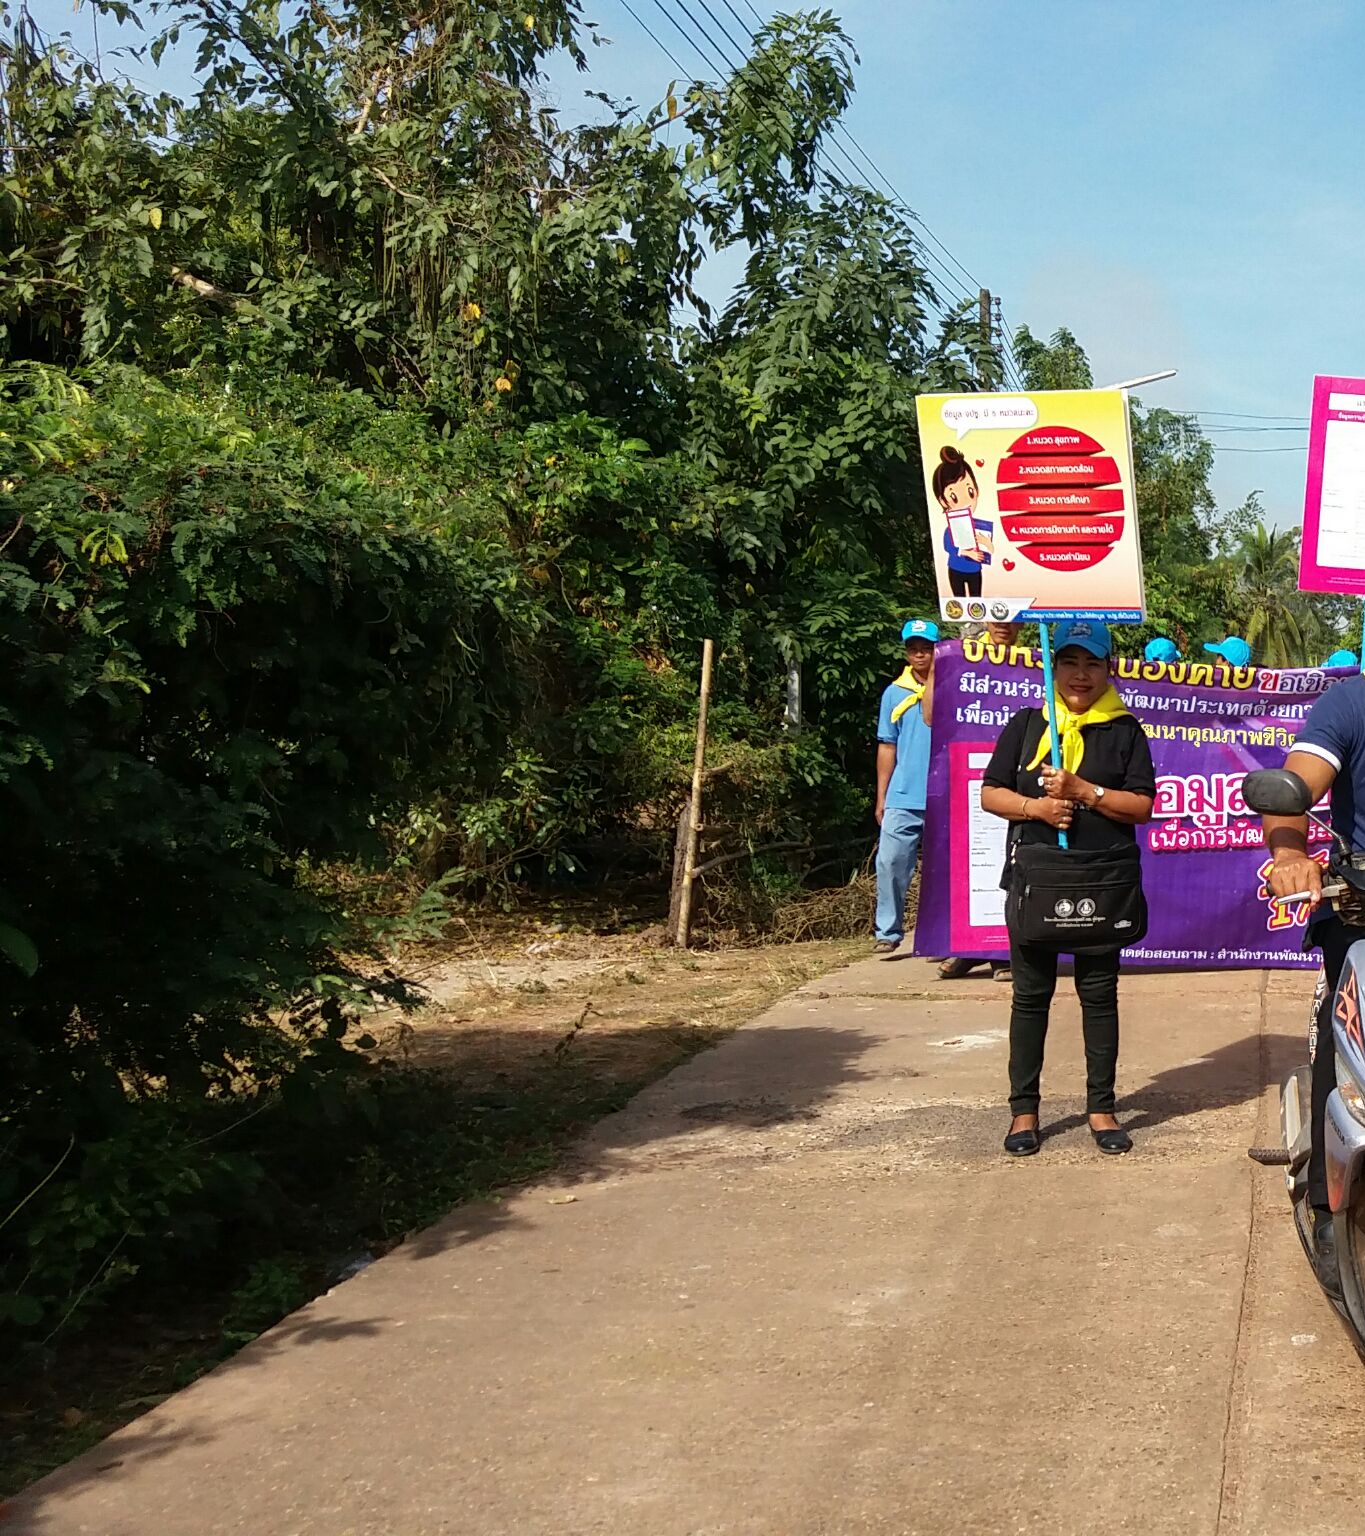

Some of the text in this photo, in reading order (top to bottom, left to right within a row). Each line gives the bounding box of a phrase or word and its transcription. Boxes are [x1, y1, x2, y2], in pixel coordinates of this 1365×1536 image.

[1151, 819, 1264, 849] เพื่อการพัฒ
